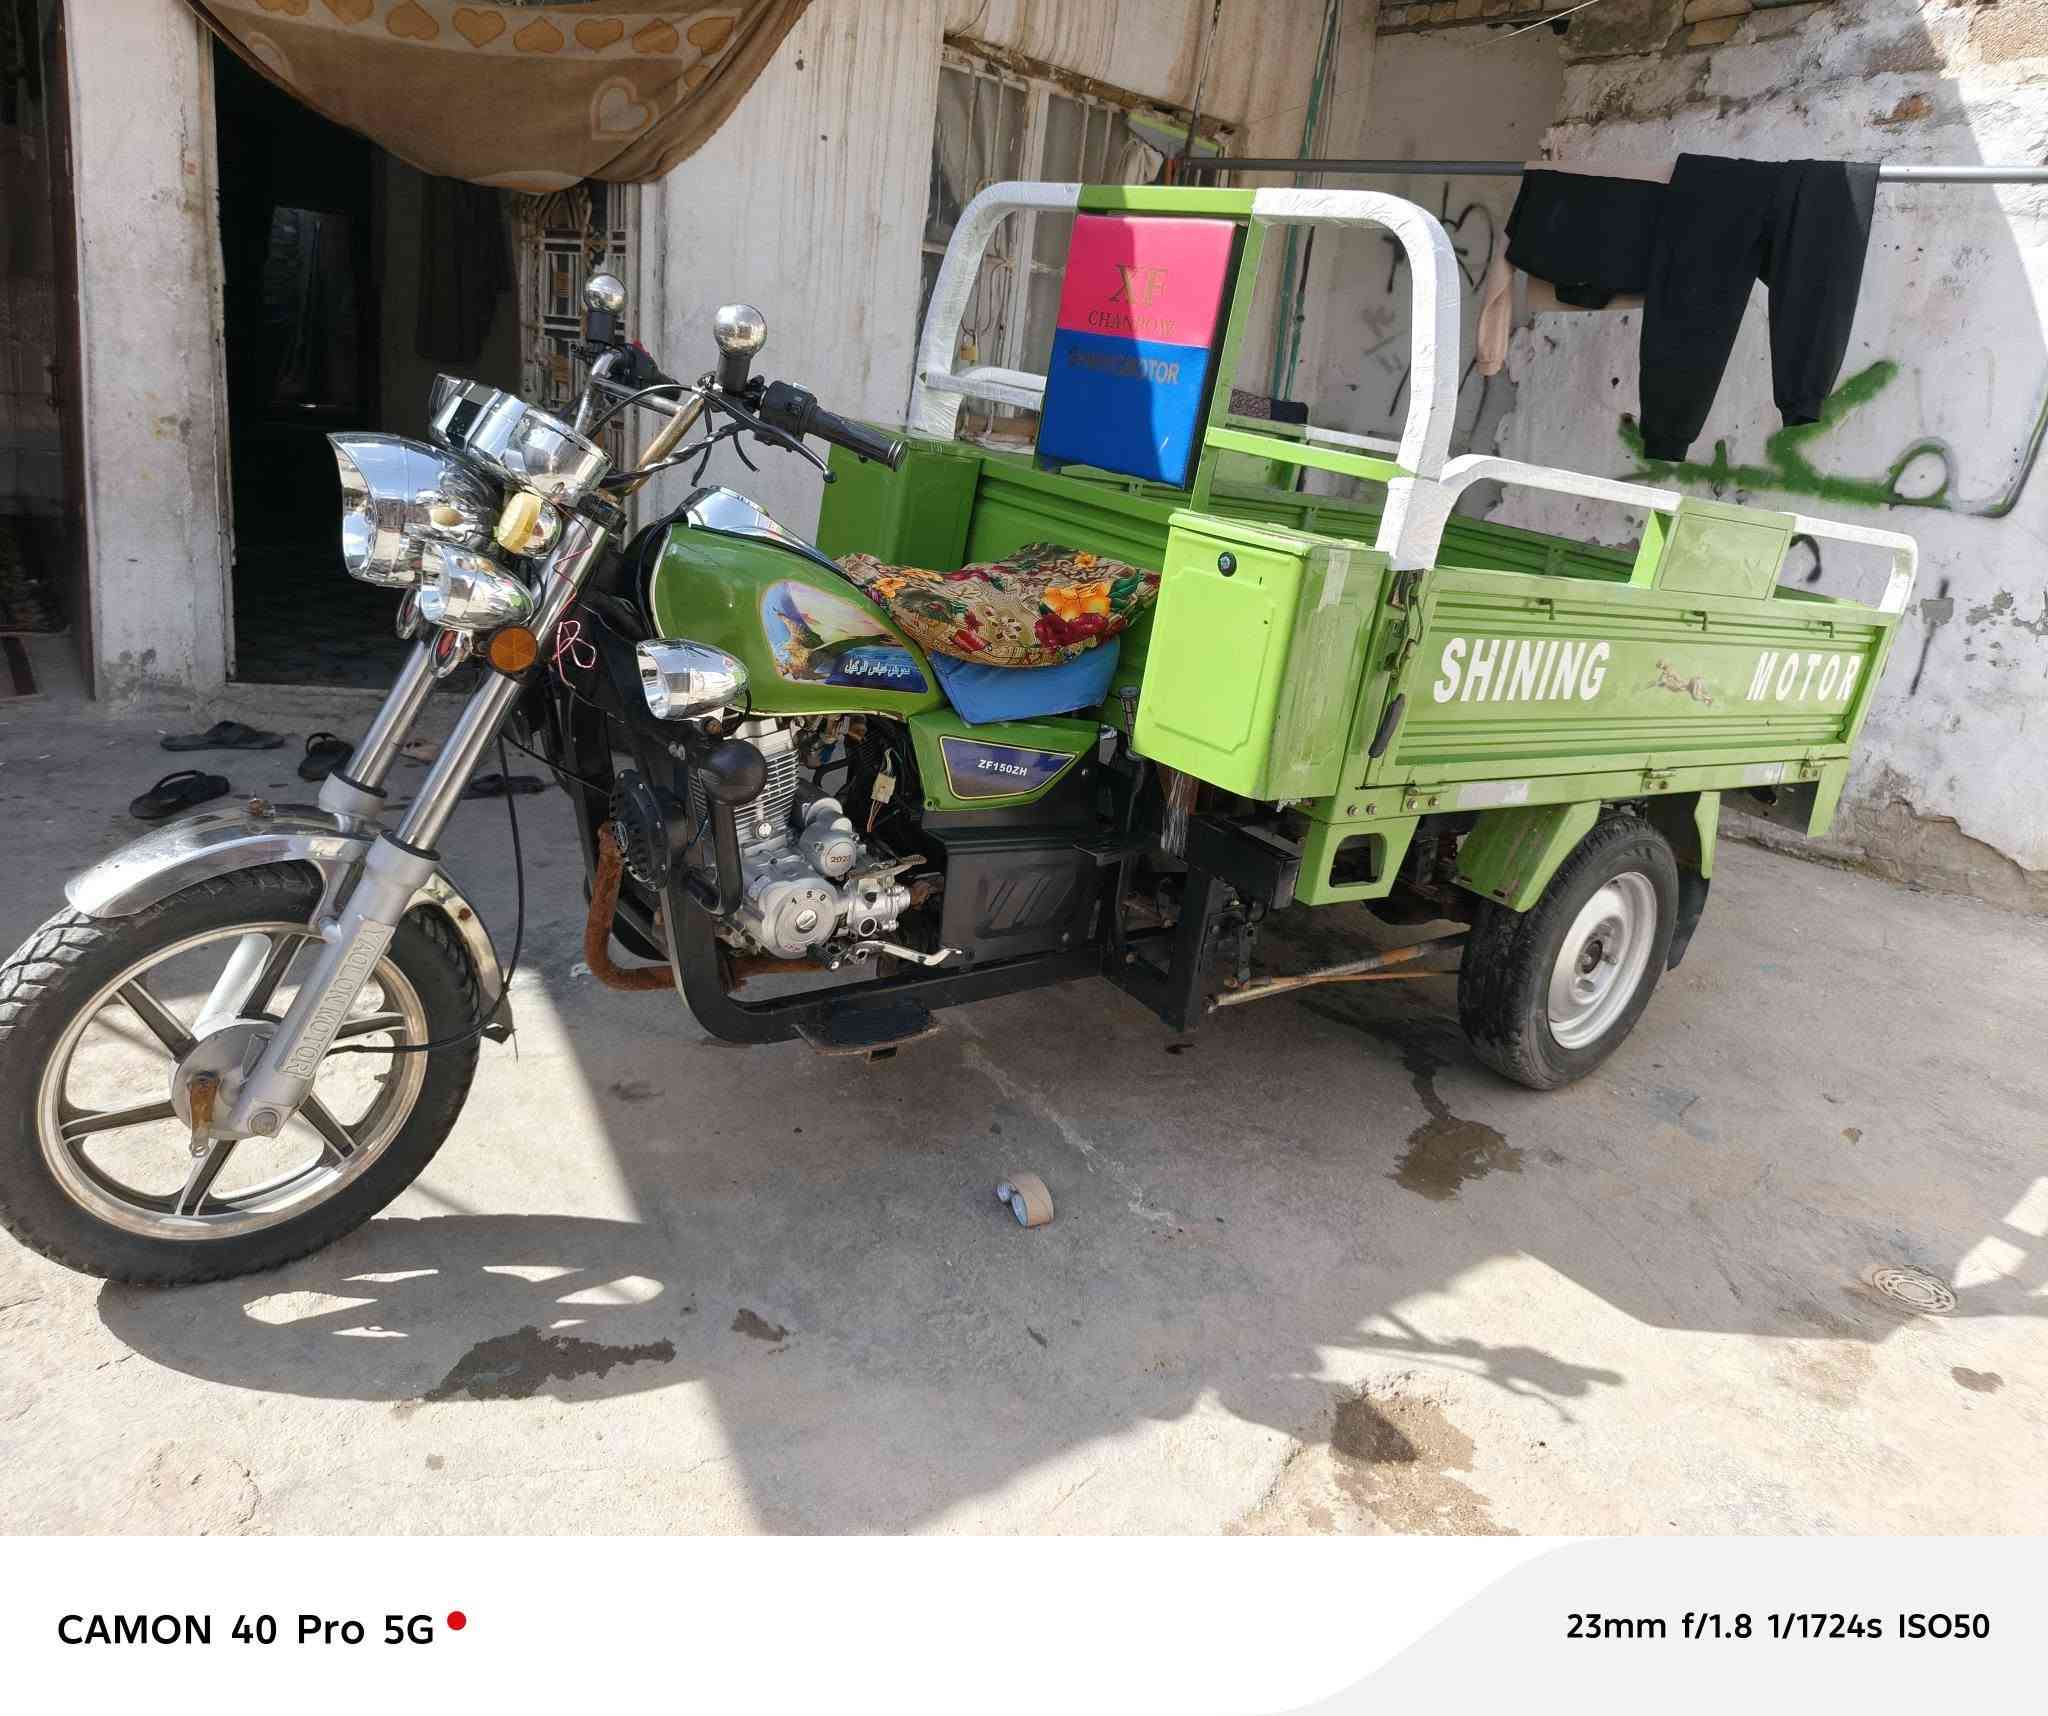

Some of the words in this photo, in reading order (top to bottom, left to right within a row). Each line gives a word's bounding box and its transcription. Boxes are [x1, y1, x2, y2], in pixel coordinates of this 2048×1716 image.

[1434, 638, 1611, 702] SHINING
[1746, 651, 1861, 701] MOTOR
[977, 759, 1028, 776] ZF150ZH
